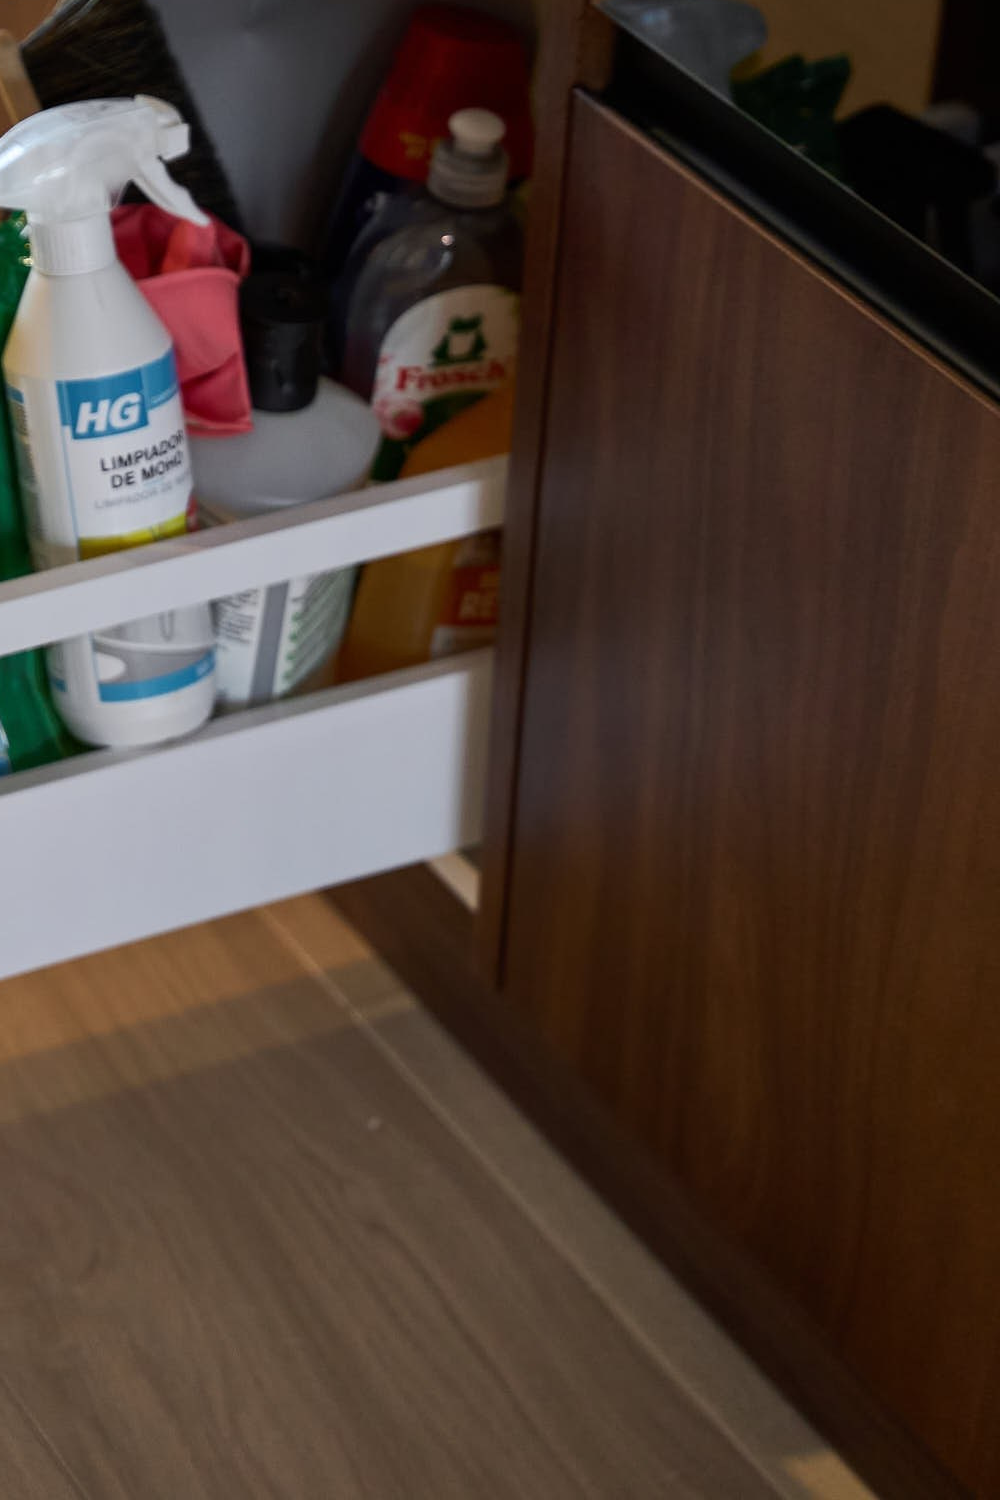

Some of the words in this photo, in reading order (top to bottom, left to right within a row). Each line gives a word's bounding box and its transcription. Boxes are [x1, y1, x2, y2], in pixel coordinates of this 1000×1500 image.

[75, 392, 141, 434] HG
[99, 429, 184, 472] LIMPIADOR
[111, 471, 135, 488] DE
